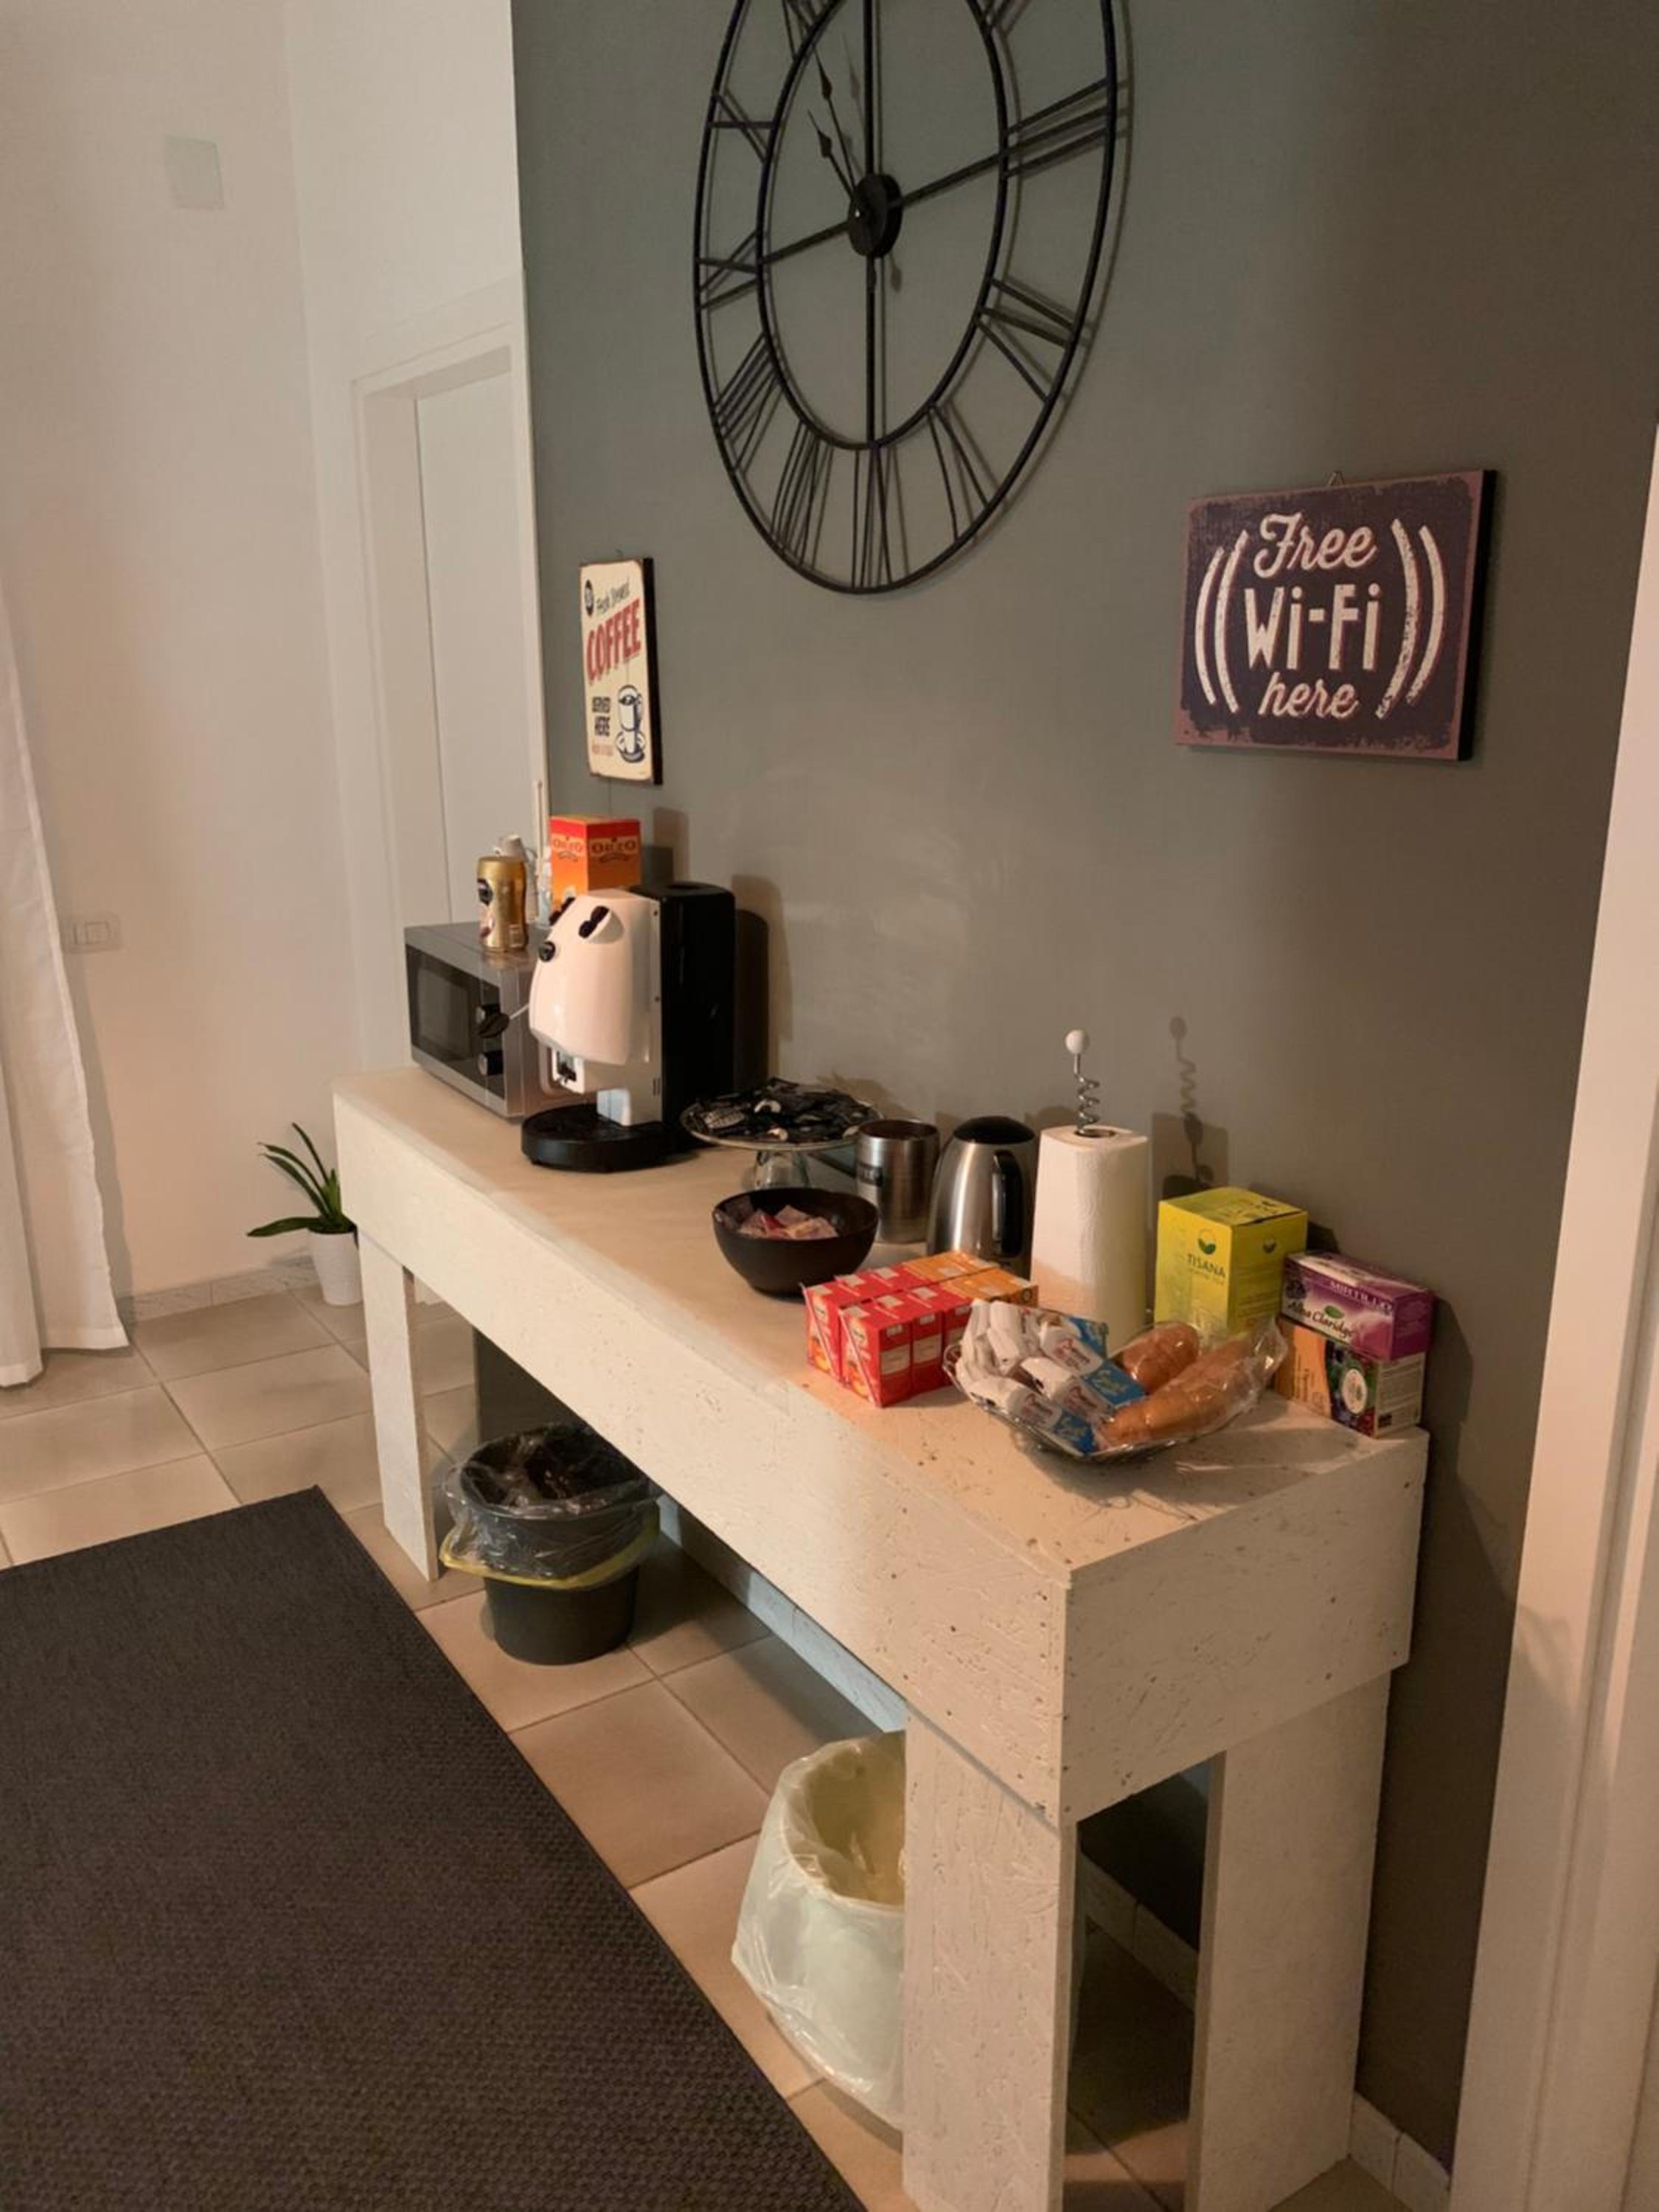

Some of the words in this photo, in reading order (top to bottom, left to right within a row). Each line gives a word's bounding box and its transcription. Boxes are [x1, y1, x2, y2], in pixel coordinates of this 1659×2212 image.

[1253, 511, 1377, 579] Free
[586, 598, 641, 685] COFFEE
[1244, 582, 1380, 670] Wi-Fi
[1258, 671, 1360, 719] here
[1187, 1252, 1226, 1279] TISANA
